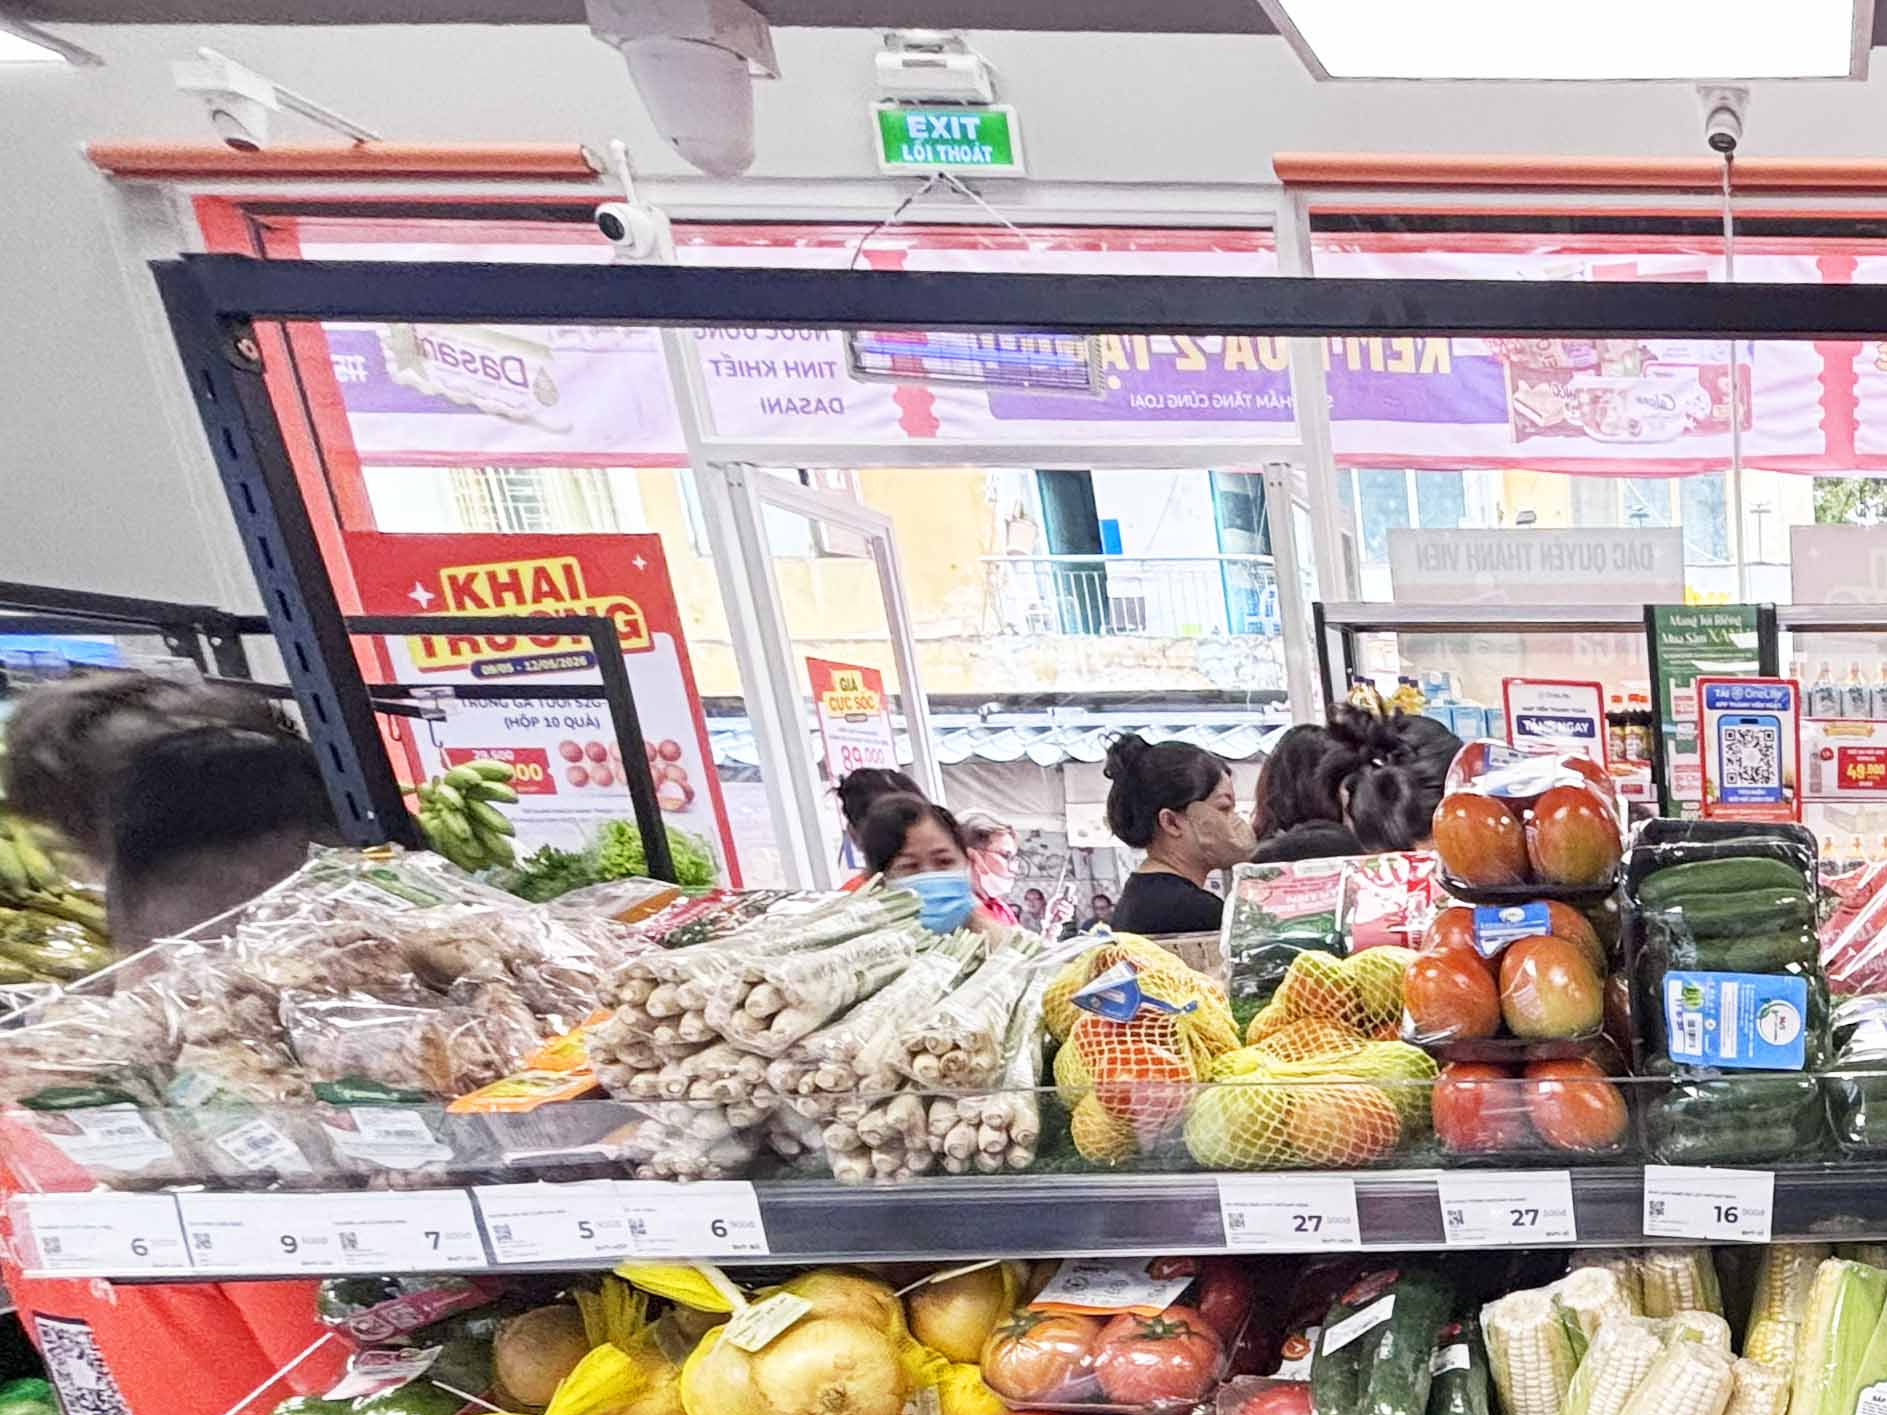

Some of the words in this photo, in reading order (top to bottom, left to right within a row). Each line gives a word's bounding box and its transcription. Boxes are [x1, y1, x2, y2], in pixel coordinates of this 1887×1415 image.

[906, 114, 981, 140] EXIT
[935, 141, 992, 162] THOÁT
[446, 563, 582, 613] KHAI
[543, 717, 561, 730] 10
[1291, 1214, 1322, 1233] 27
[1509, 1208, 1540, 1227] 27
[1713, 1206, 1739, 1224] 16
[577, 1220, 595, 1240] 5
[711, 1218, 728, 1238] 6
[131, 1238, 149, 1257] 6
[280, 1235, 298, 1254] 9
[424, 1231, 441, 1250] 7
